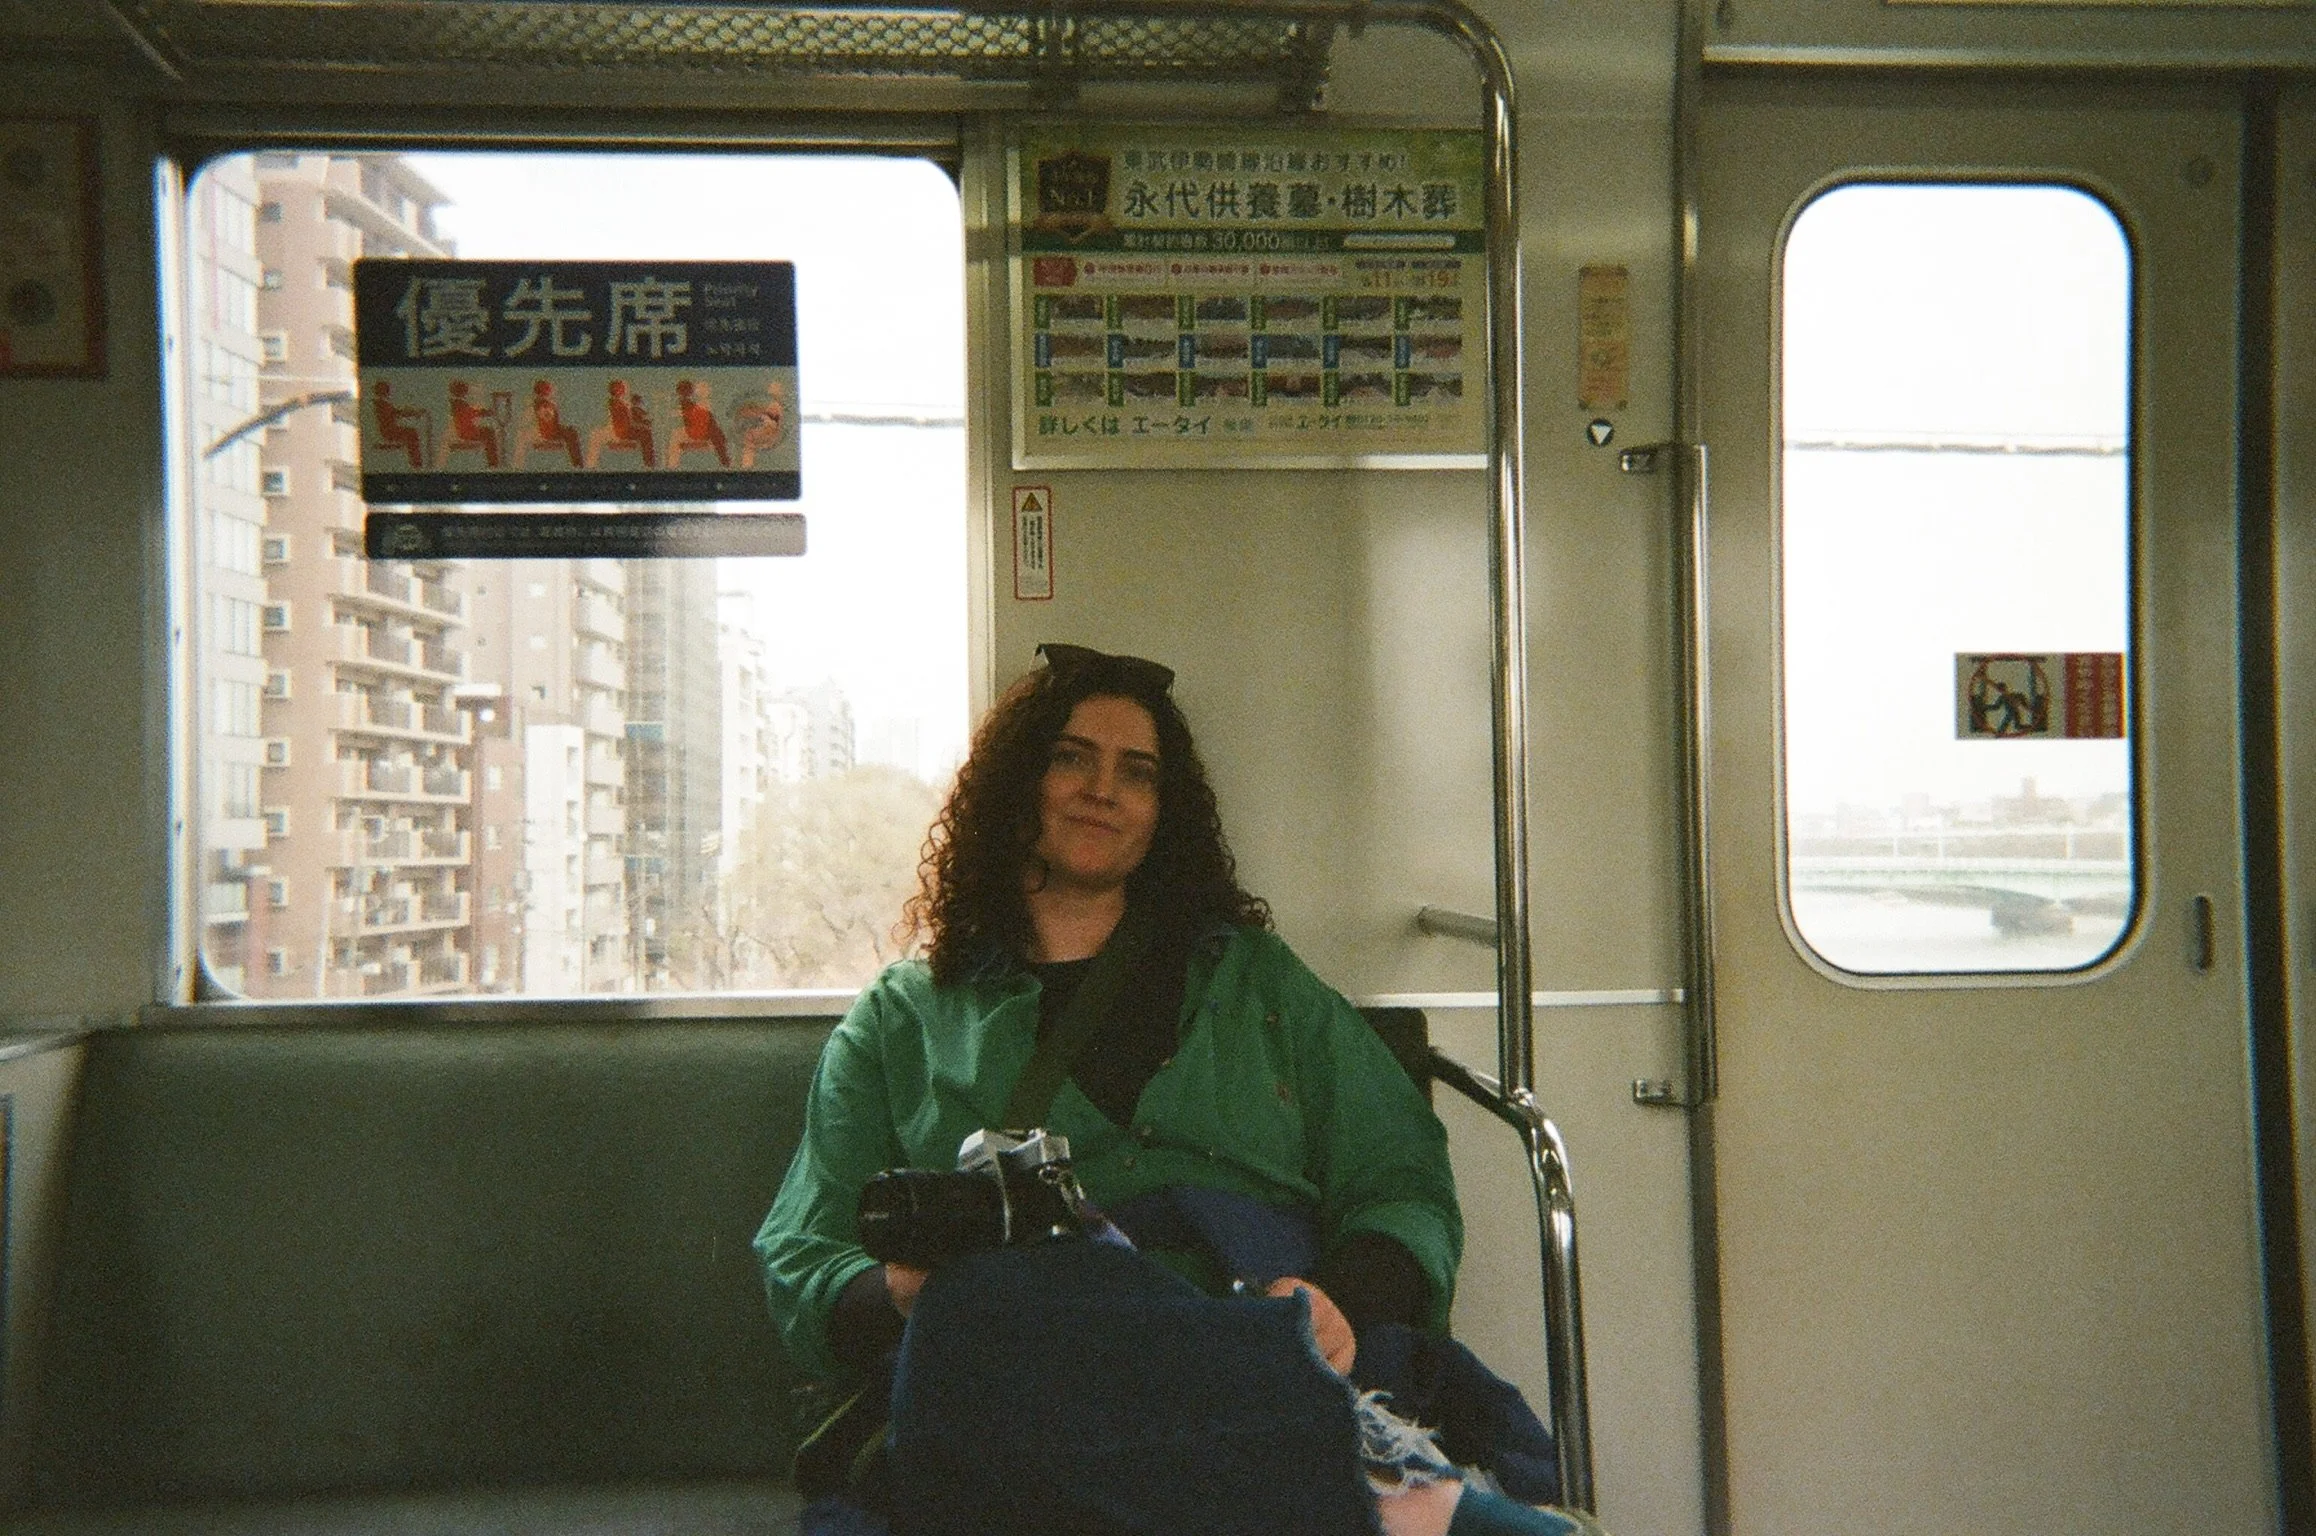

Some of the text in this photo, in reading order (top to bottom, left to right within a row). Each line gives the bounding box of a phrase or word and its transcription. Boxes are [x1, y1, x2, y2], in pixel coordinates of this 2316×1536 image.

[397, 274, 694, 359] 優先席
[1038, 415, 1119, 435] 詳しくは
[1132, 415, 1212, 435] エータイ
